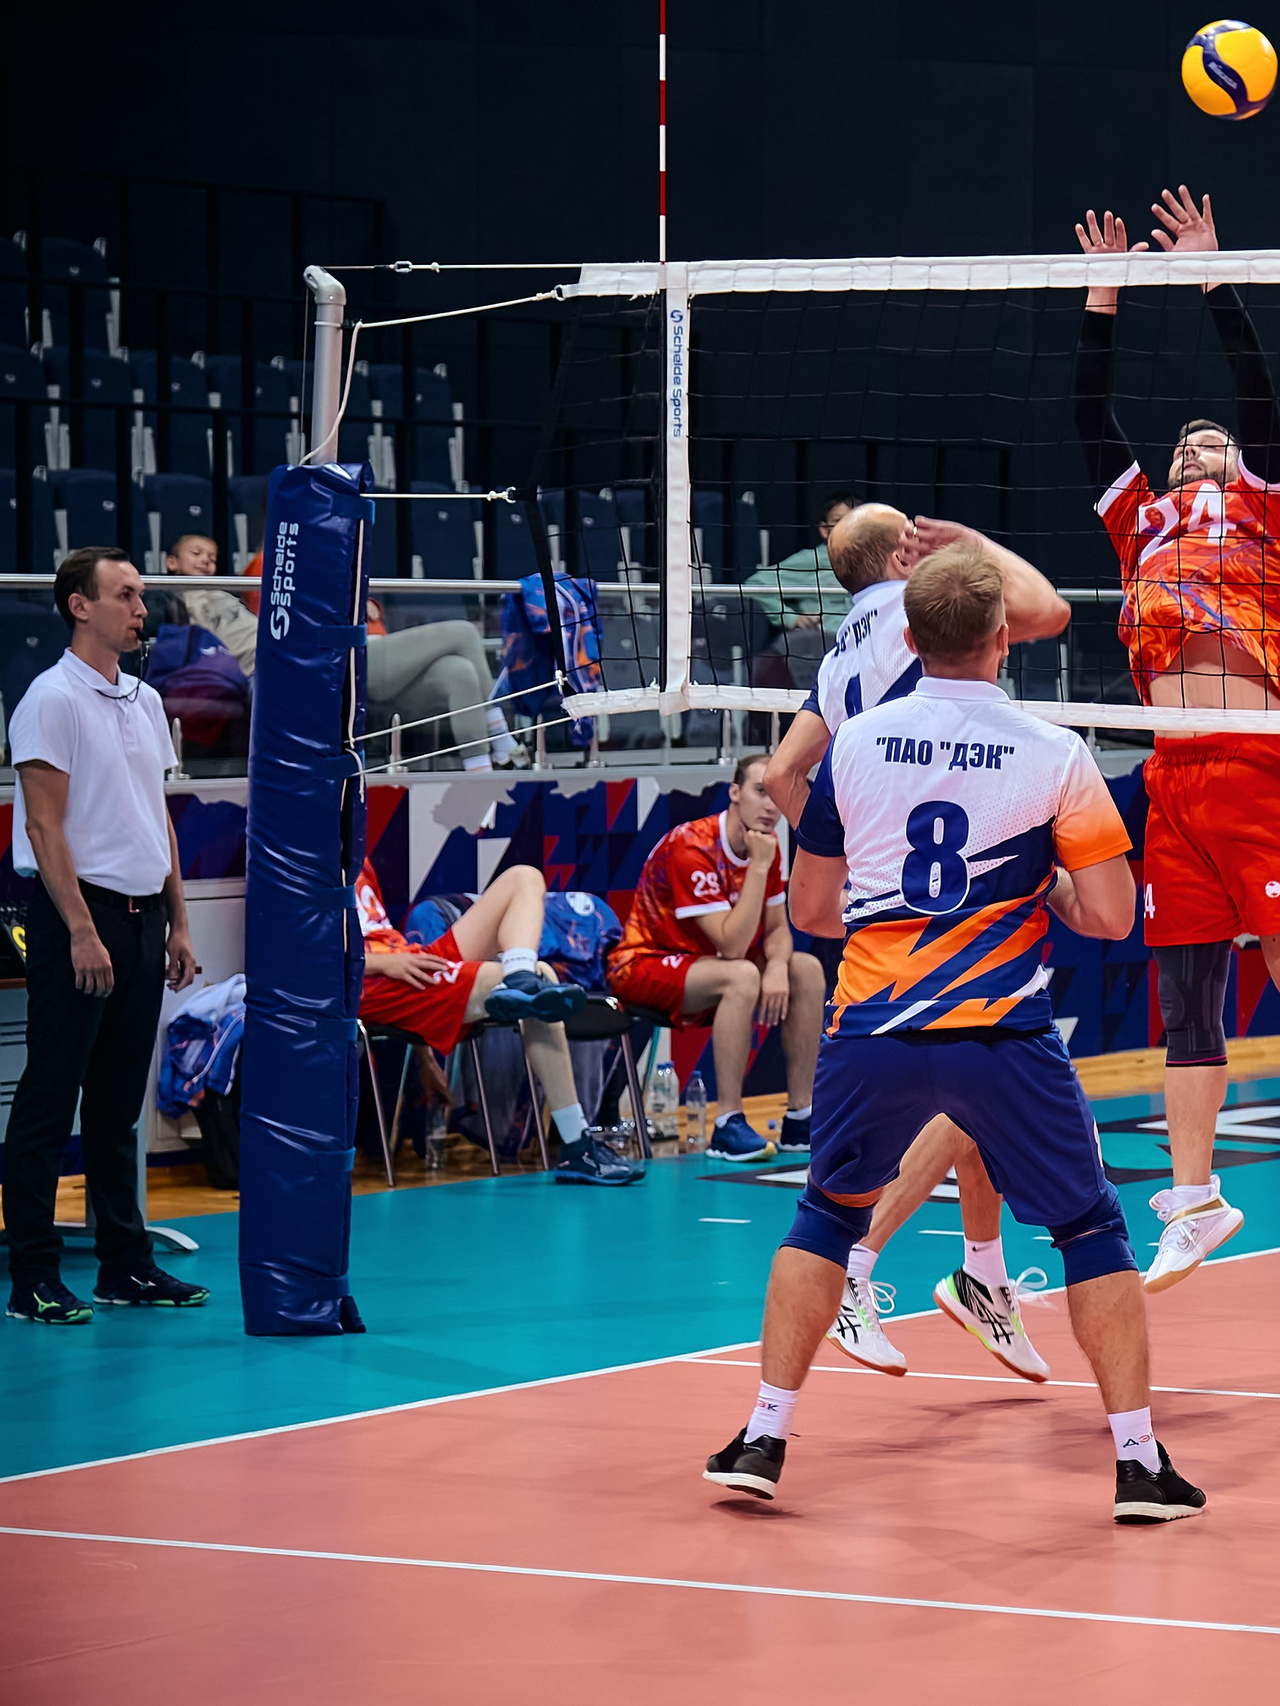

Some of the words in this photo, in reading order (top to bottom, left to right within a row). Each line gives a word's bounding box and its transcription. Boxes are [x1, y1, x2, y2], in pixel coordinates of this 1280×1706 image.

[673, 326, 683, 385] Schelde
[670, 388, 683, 437] Sports
[1137, 482, 1237, 567] 24
[876, 736, 933, 766] "ПАО
[940, 741, 1015, 771] "ДЭК"
[902, 800, 970, 914] 8
